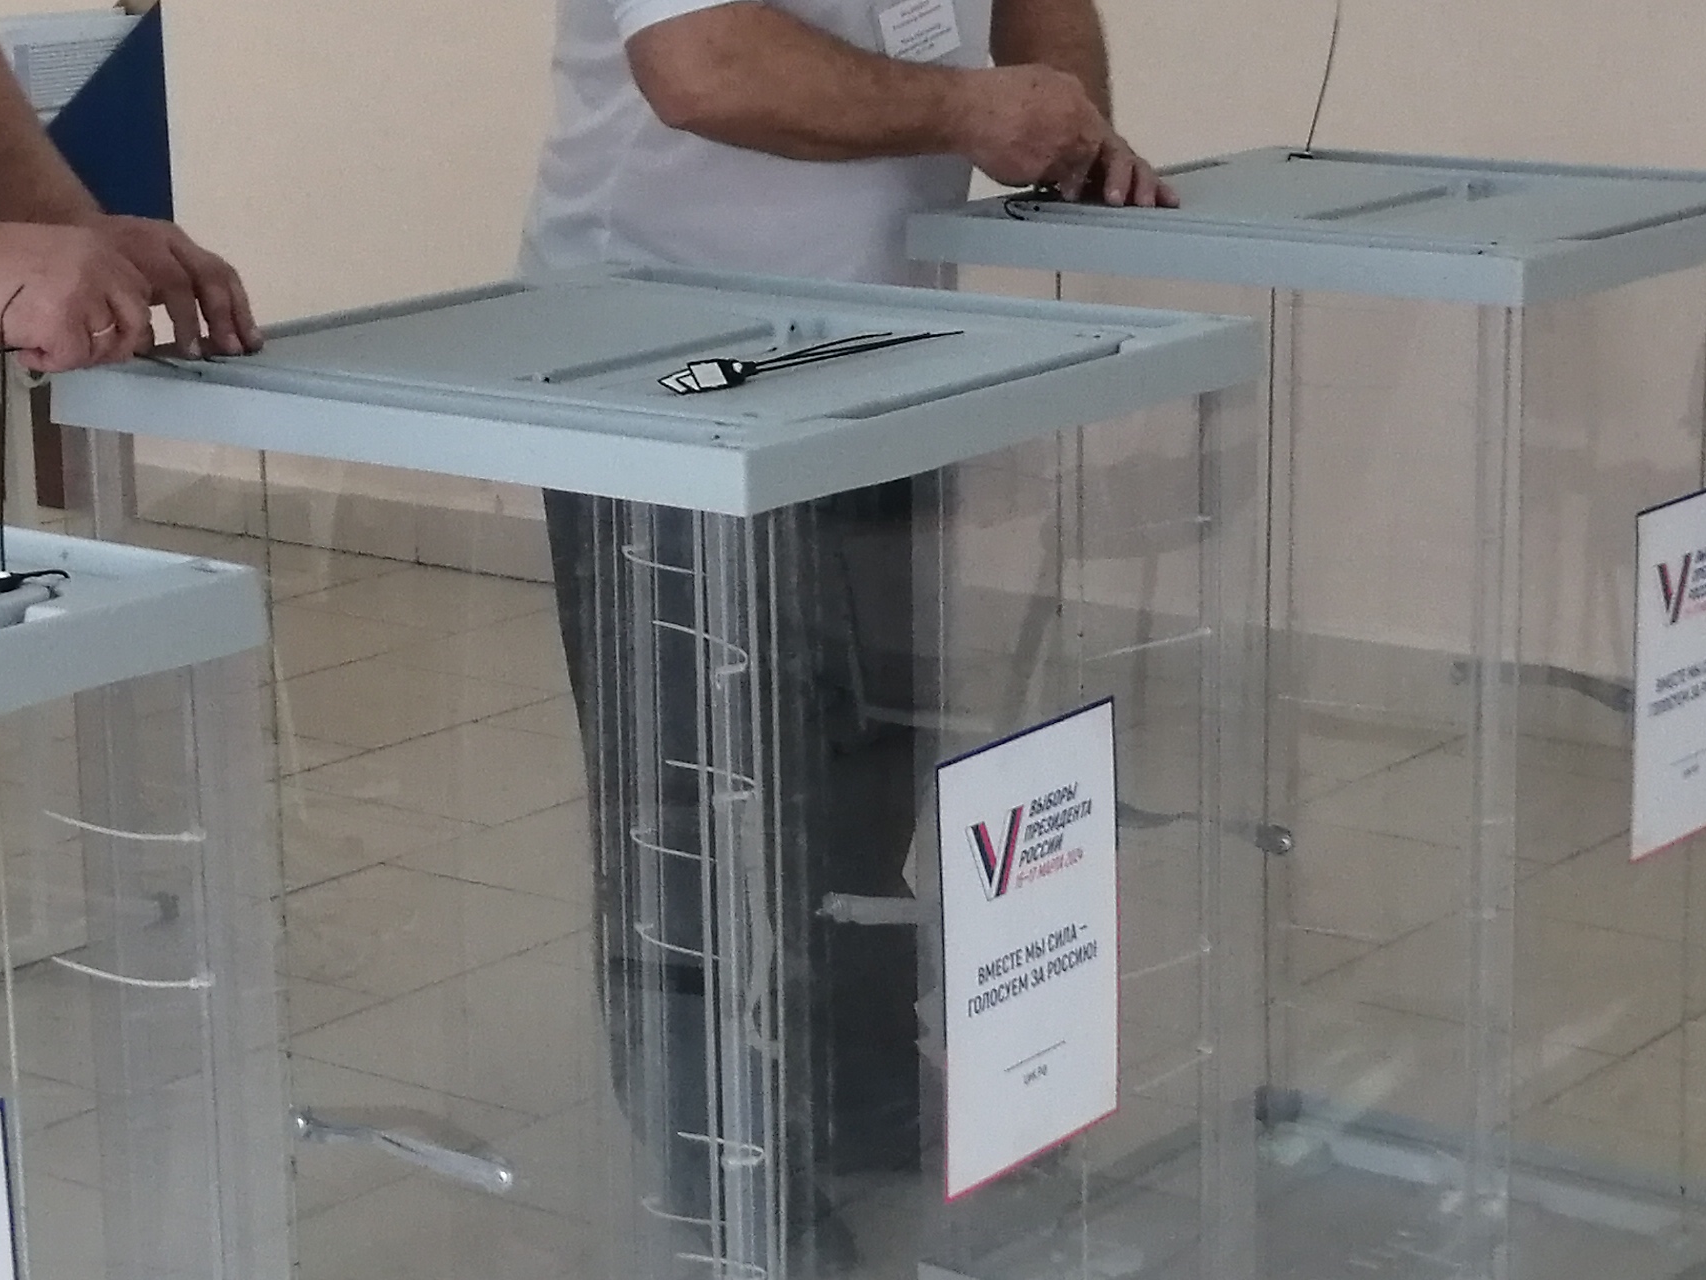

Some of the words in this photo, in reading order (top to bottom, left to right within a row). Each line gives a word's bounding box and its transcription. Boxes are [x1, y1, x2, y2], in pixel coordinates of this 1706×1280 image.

[1024, 798, 1092, 843] ПРЕЗИДЕНТА
[1029, 781, 1078, 818] ВЫБОРЫ
[1019, 832, 1063, 868] РОССИИ
[968, 972, 1029, 1018] ГОЛОСУЕМ
[1031, 965, 1045, 989] ЗА
[1047, 938, 1098, 980] РОССИЮ!
[977, 950, 1023, 987] ВМЕСТЕ
[1026, 938, 1045, 965] МЫ
[1047, 924, 1077, 956] СИЛА
